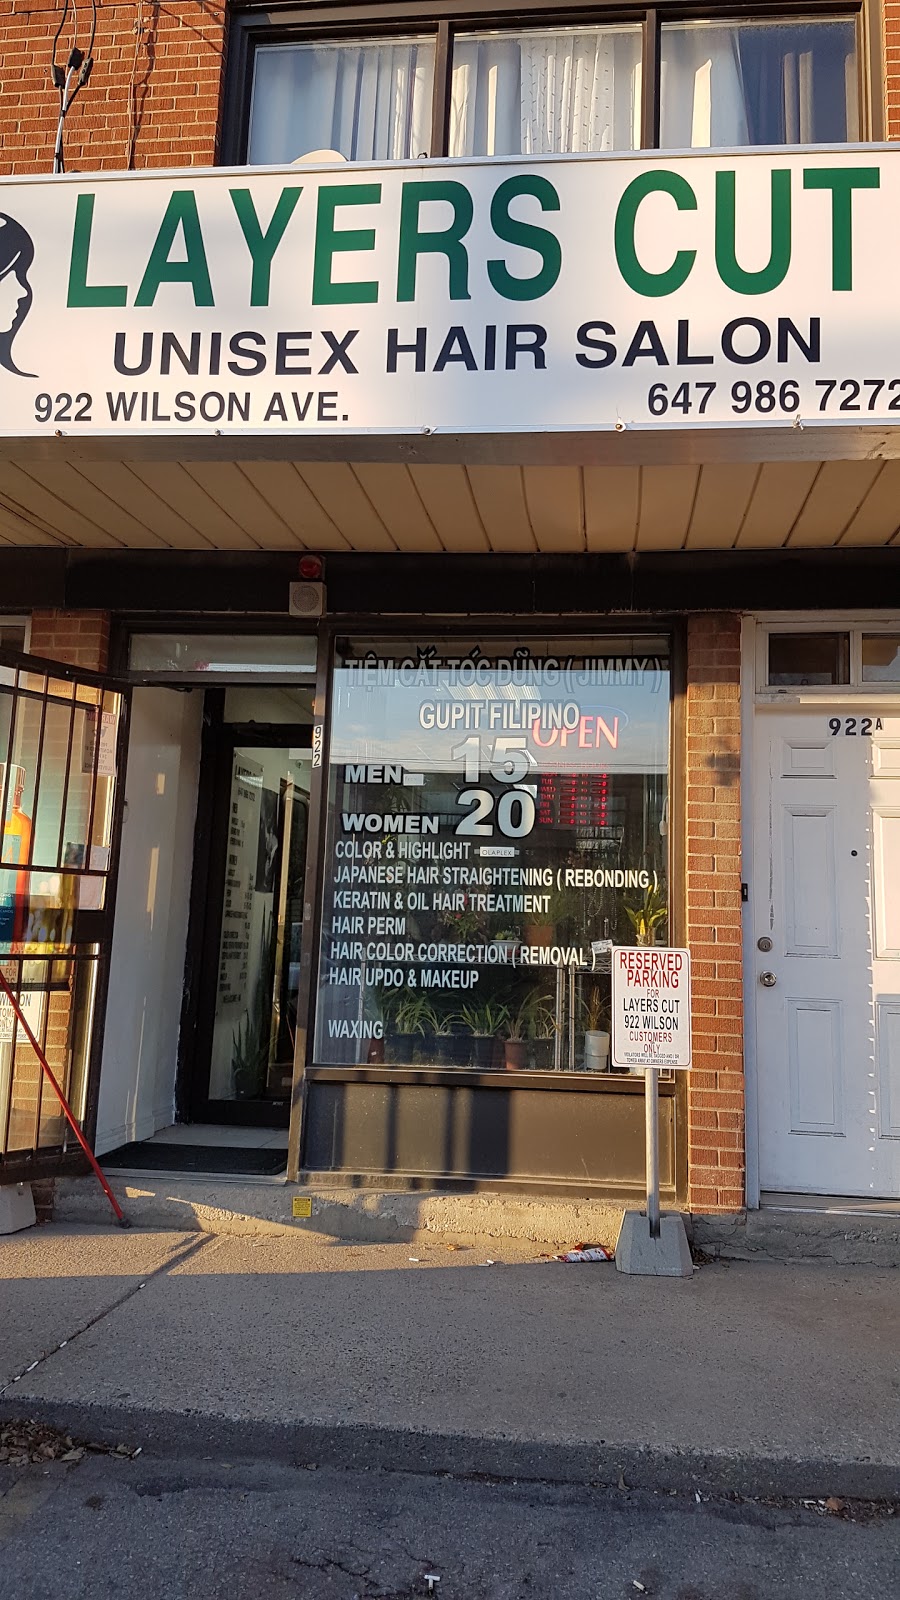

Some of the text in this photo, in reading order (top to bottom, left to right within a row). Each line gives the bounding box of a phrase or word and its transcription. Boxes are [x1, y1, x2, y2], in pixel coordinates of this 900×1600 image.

[66, 166, 880, 308] LAYERS CUT
[113, 316, 821, 376] UNISEX HAIR SALON
[34, 391, 349, 423] 922 WILSON AVE.
[648, 379, 900, 416] 647 986 7272
[344, 653, 394, 691] TIỆM
[400, 649, 442, 687] CẮT
[447, 649, 491, 687] TÓC
[497, 649, 561, 687] DŨNG
[419, 702, 580, 730] GUPIT FILIPINO
[314, 726, 322, 767] 922
[345, 736, 530, 784] MEN 15
[342, 813, 439, 834] WOMEN
[455, 788, 536, 838] 20
[335, 841, 471, 860] COLOR & HIGHLIGHT
[333, 866, 404, 884] JAPANESE
[407, 867, 439, 885] HAIR
[442, 867, 553, 887] STRAIGHTENING
[333, 891, 552, 913] KERATIN & OIL HAIR TREATMENT
[332, 916, 406, 935] HAIR PERM
[330, 942, 363, 960] HAIR
[366, 942, 415, 961] COLOR
[417, 943, 508, 962] CORRECTION
[620, 952, 683, 971] RESERVED
[329, 967, 479, 989] HAIR UPDO & MAKEUP
[627, 970, 679, 988] PARKING
[646, 989, 660, 998] FOR
[623, 998, 680, 1013] LAYERS CUT
[328, 1020, 383, 1039] WAXING
[624, 1015, 679, 1030] 922 WILSON
[629, 1031, 673, 1042] CUSTOMERS
[643, 1044, 661, 1054] ONLY
